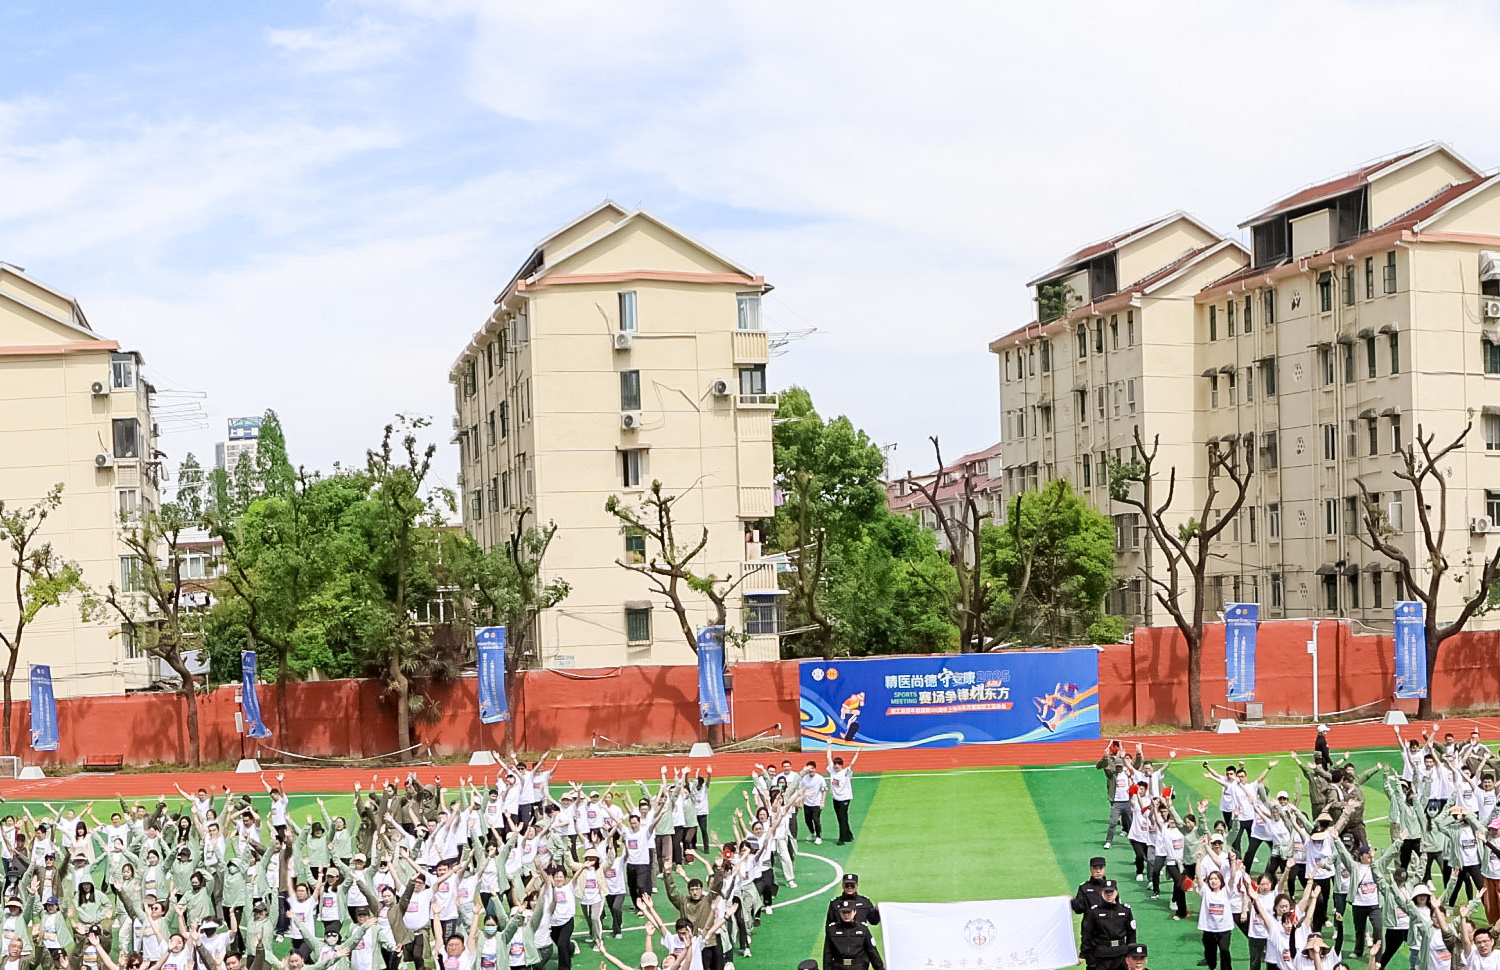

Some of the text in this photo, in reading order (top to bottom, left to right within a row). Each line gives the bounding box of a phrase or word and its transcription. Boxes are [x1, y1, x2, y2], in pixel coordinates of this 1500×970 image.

[884, 667, 1011, 689] 精医尚德守安康 2025
